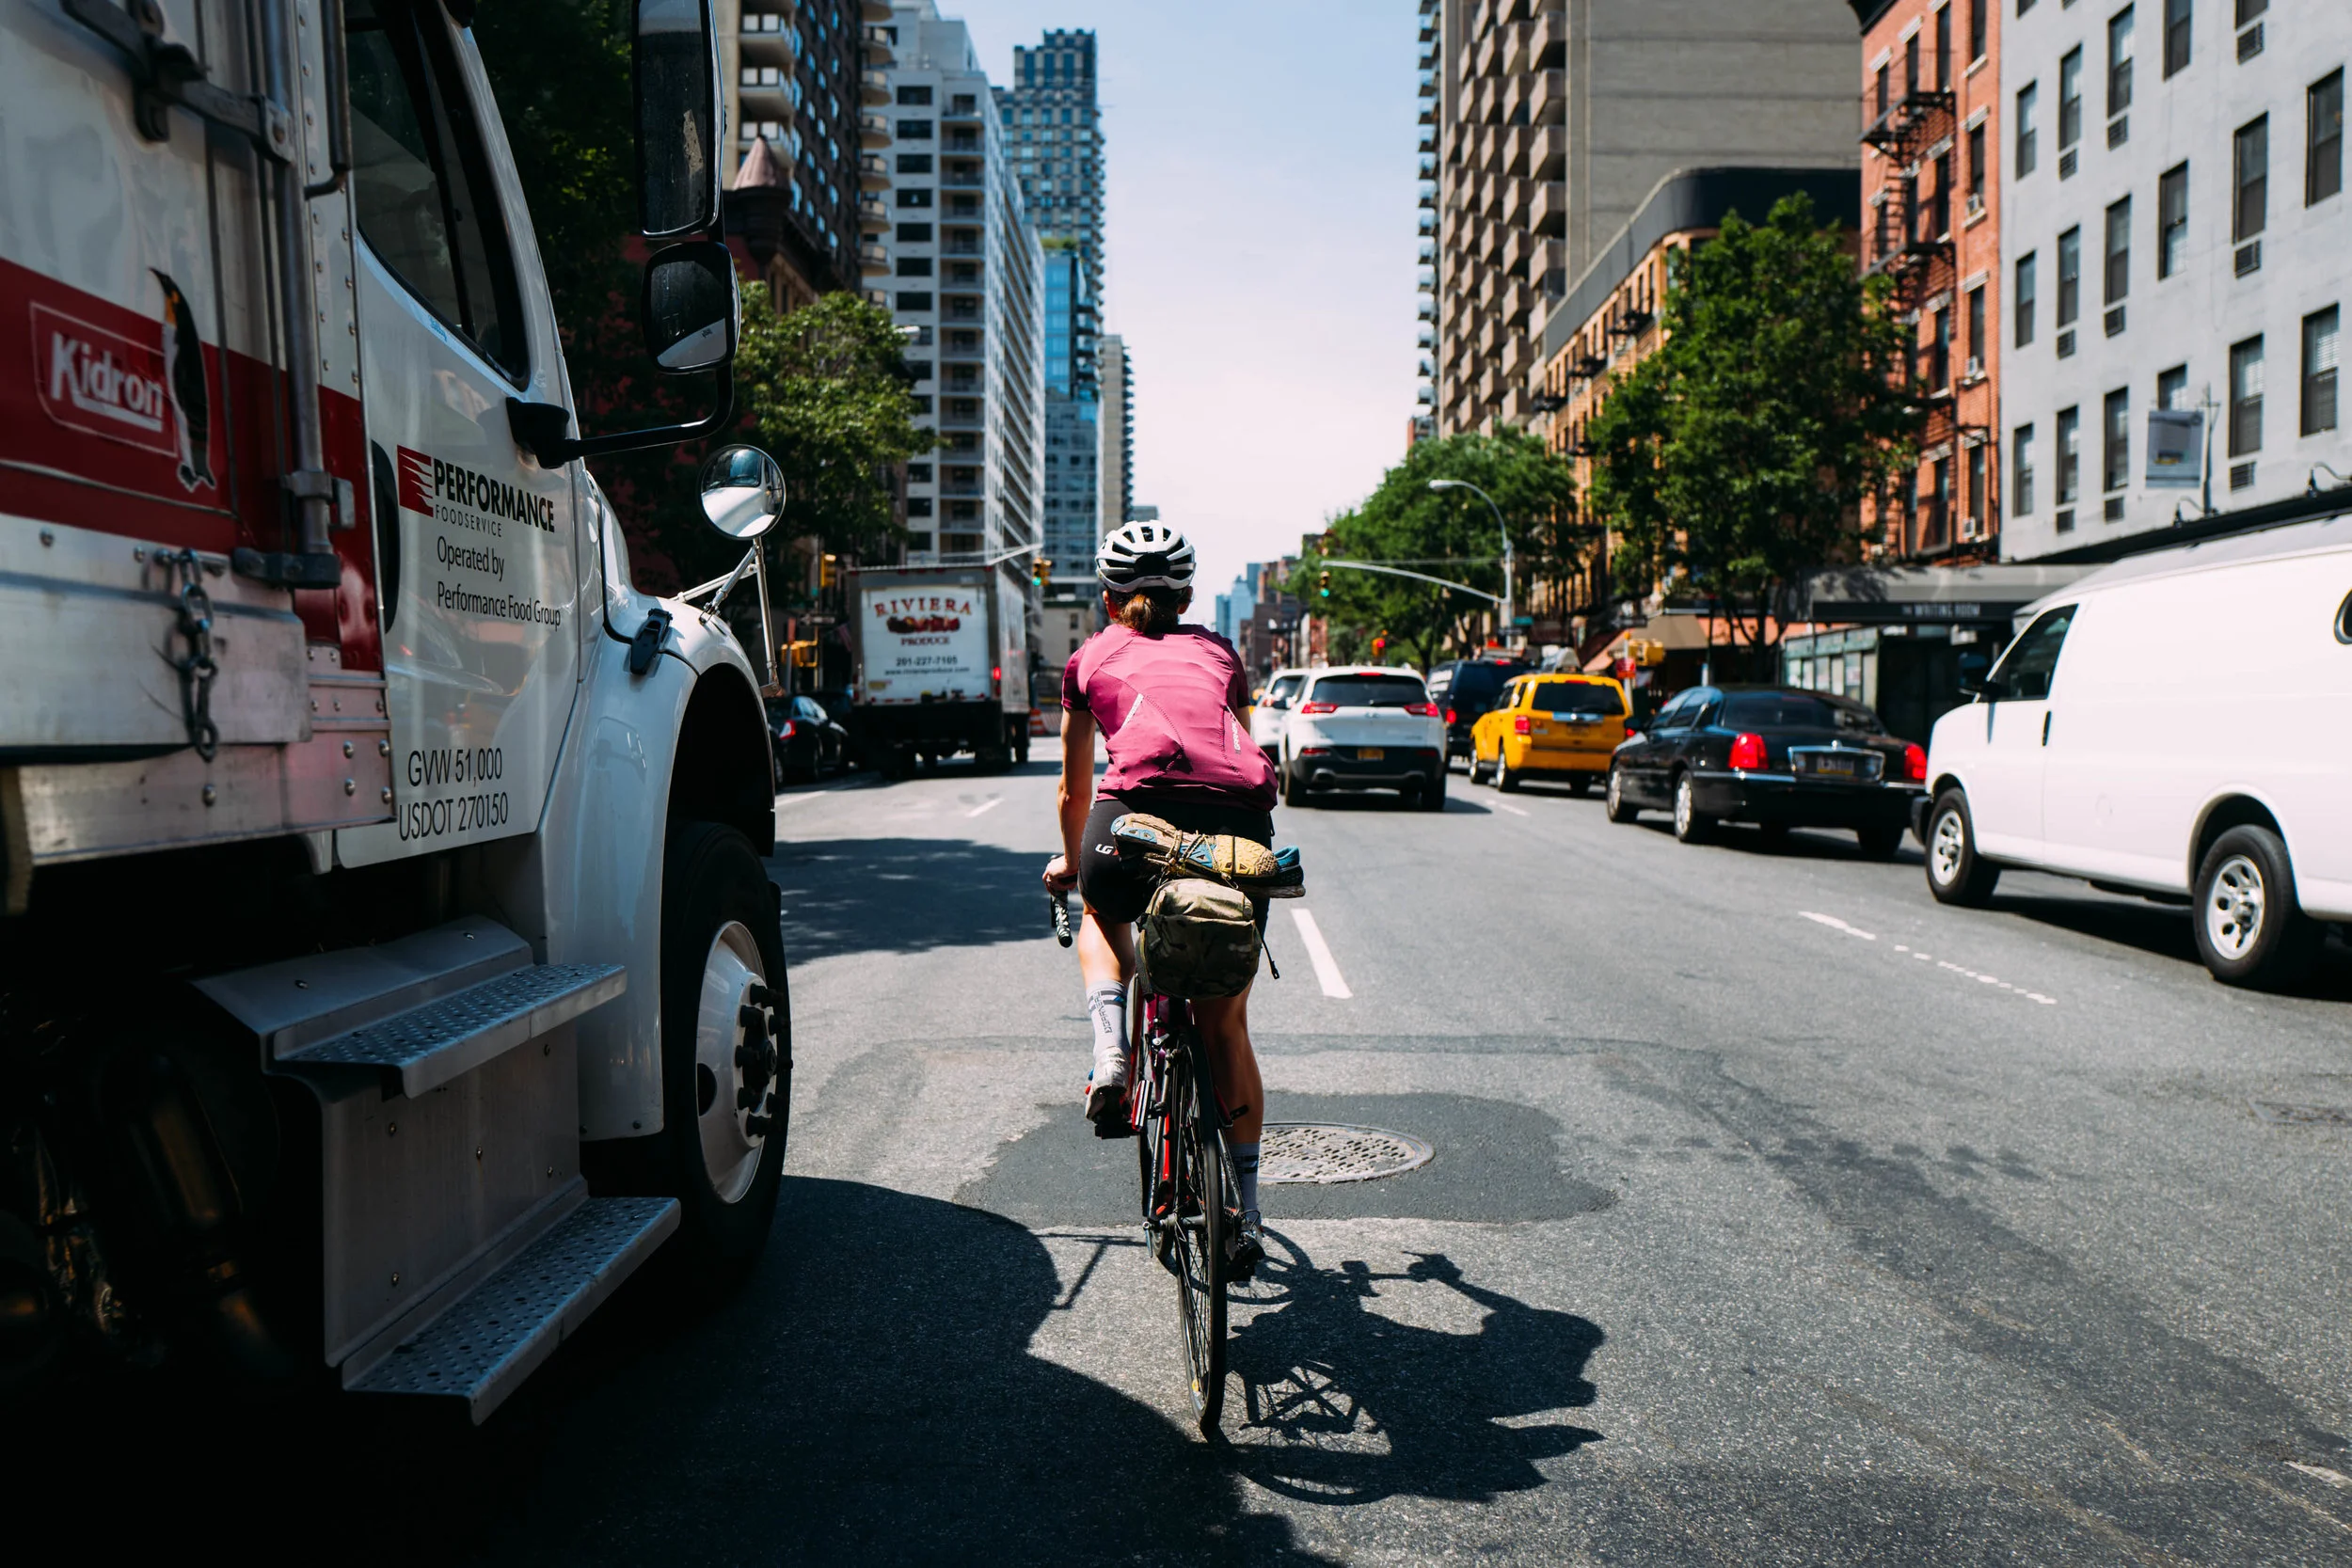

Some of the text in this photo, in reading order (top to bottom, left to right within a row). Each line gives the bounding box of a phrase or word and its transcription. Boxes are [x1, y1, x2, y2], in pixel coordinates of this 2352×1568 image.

[51, 330, 164, 420] Kidron
[434, 458, 555, 533] PERFORMANCE
[436, 504, 502, 538] FOODSERVICE
[437, 535, 505, 582] Operated by
[437, 580, 562, 632] Performance Food Group
[874, 596, 972, 617] RIVIERA
[900, 637, 950, 646] PRODUCE
[407, 747, 502, 788] GVW 51,000
[399, 791, 508, 842] USDOT 270150
